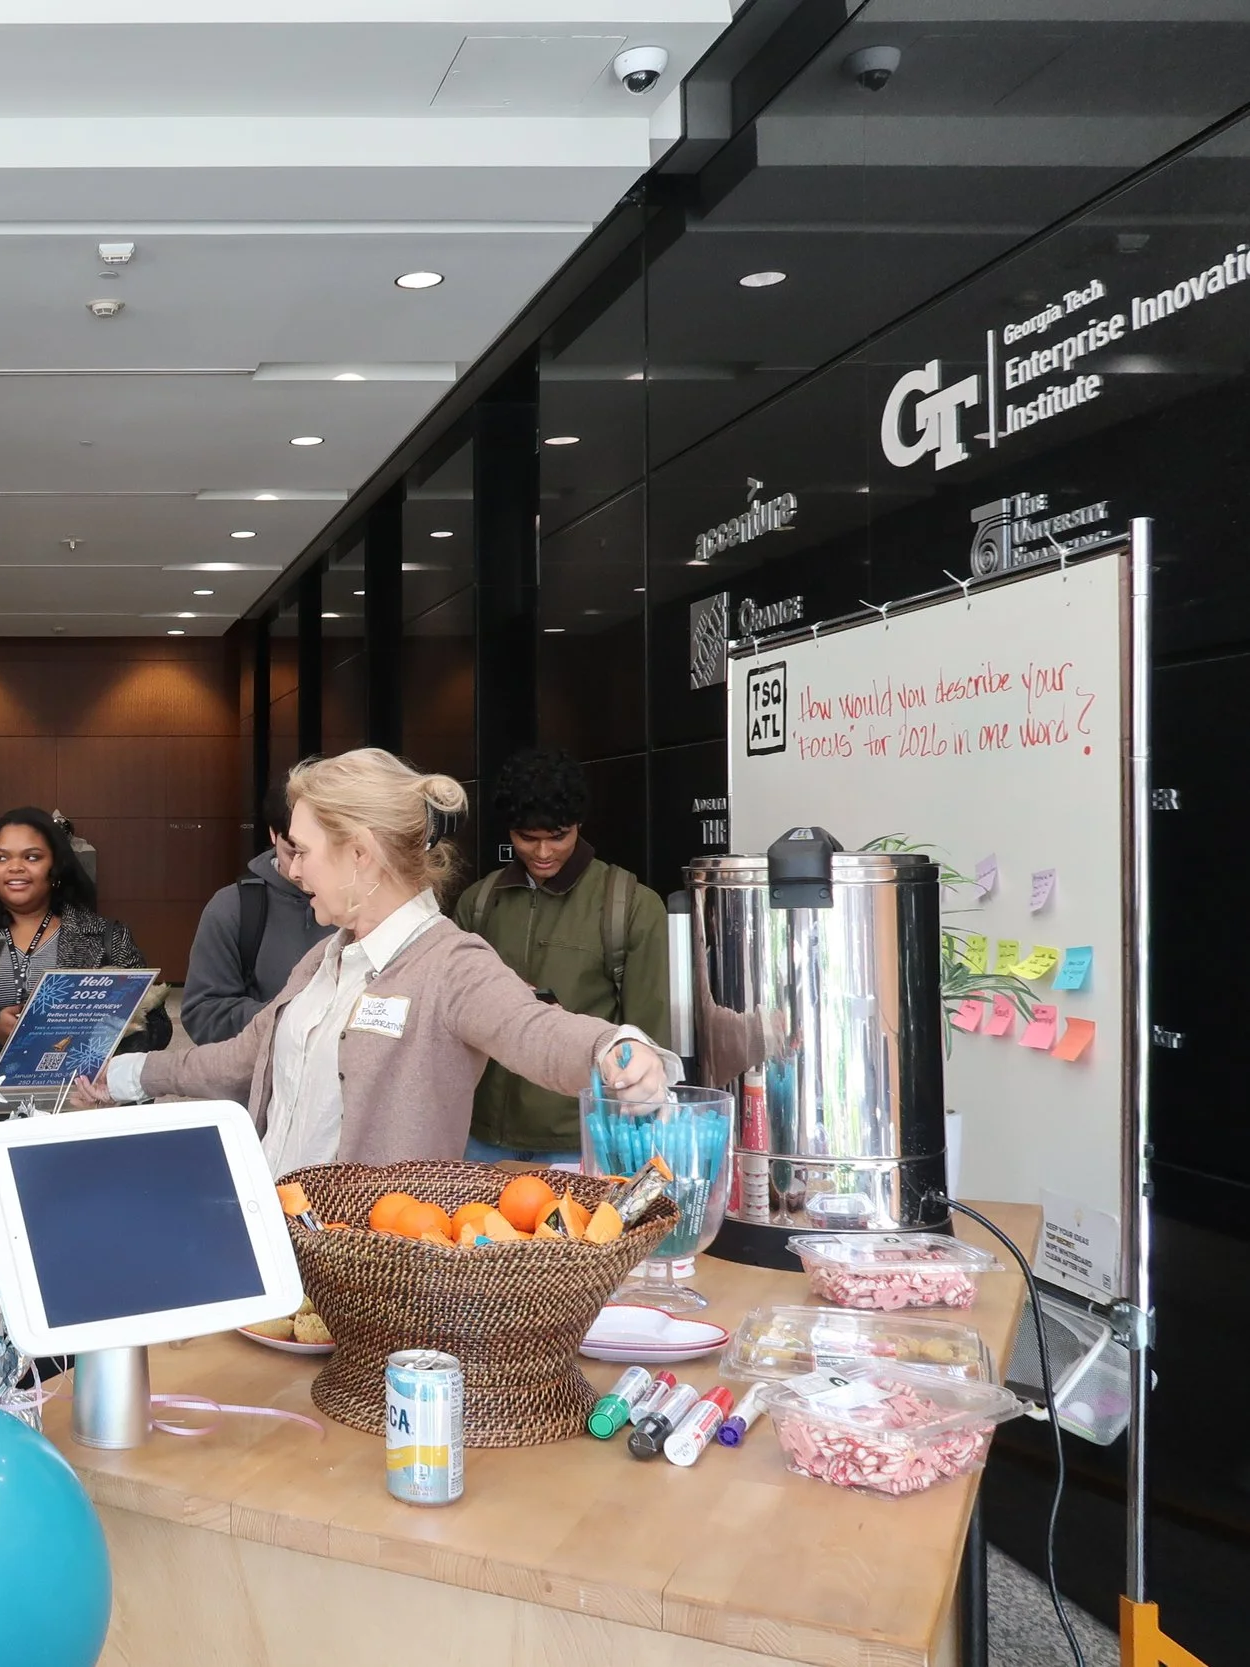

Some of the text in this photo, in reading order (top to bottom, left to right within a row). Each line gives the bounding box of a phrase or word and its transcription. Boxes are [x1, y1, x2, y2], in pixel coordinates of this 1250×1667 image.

[1004, 279, 1106, 345] Georgia Tech
[1005, 313, 1128, 390] Enterprise
[880, 359, 981, 471] GT
[1006, 372, 1103, 434] Institute
[694, 492, 797, 561] accenture
[752, 679, 782, 708] TSQ
[798, 661, 1073, 723] How would you describe your
[750, 714, 781, 741] ATL
[864, 725, 892, 757] for
[899, 723, 948, 758] 2026
[950, 721, 972, 755] in
[979, 722, 1009, 751] one
[71, 991, 107, 1000] 2026
[79, 976, 114, 987] Hello
[1059, 1227, 1073, 1238] YOUR
[1074, 1233, 1090, 1246] IDEAS
[1045, 1251, 1061, 1264] CLEAN
